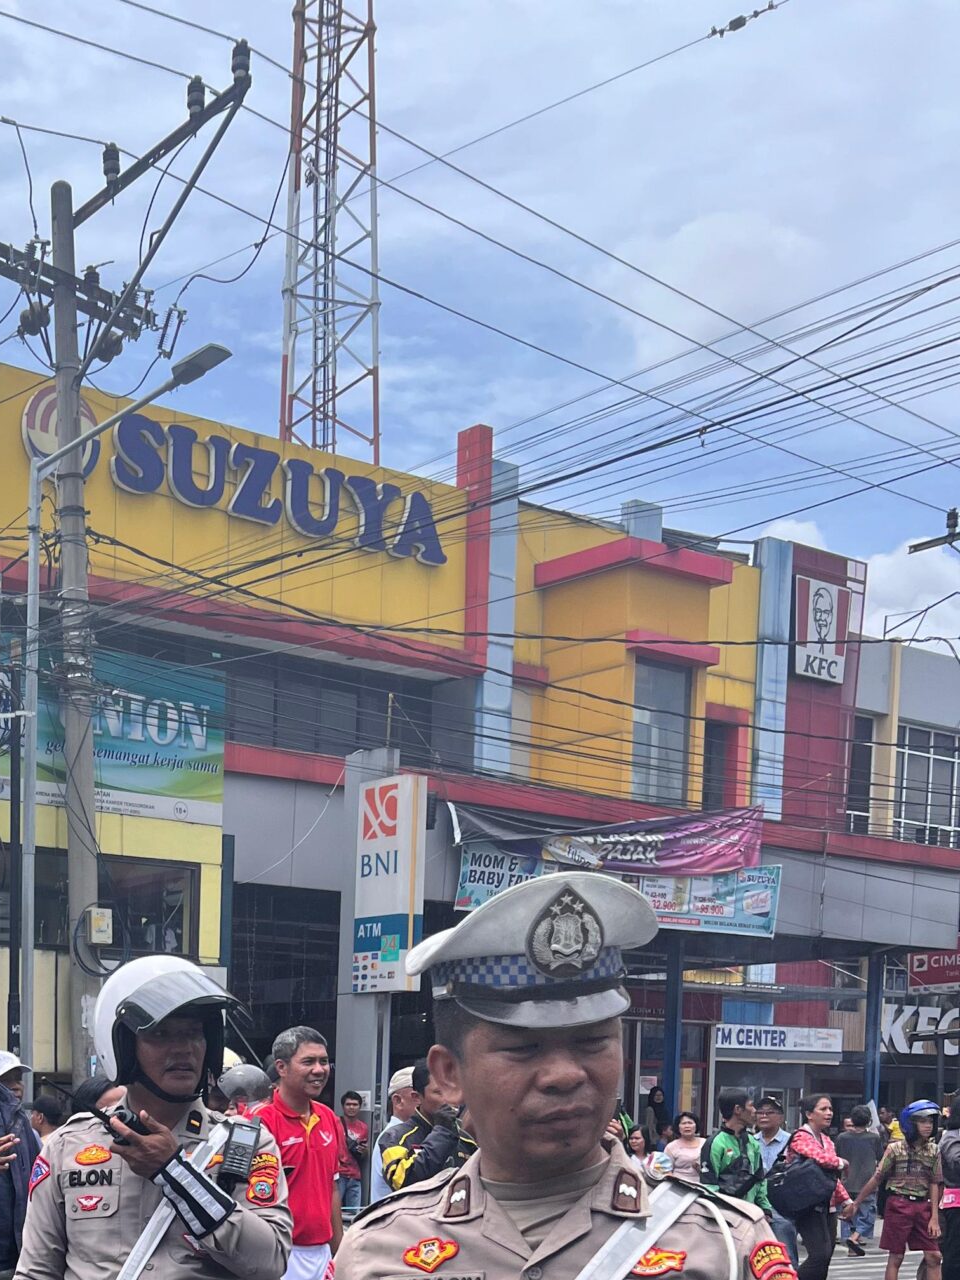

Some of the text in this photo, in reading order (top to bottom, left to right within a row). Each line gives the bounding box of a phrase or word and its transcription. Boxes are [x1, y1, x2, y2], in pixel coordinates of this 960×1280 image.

[111, 412, 448, 566] SUZUYA
[803, 654, 838, 679] KFC
[59, 694, 210, 751] NION
[154, 752, 184, 770] kerja
[187, 760, 219, 774] sama
[360, 850, 398, 878] BNI
[470, 852, 519, 872] MOM &
[468, 869, 537, 888] BABY FAI
[357, 922, 382, 938] ATM
[381, 935, 397, 953] 24
[715, 1027, 787, 1048] TM CENTER
[69, 1169, 113, 1187] ELON
